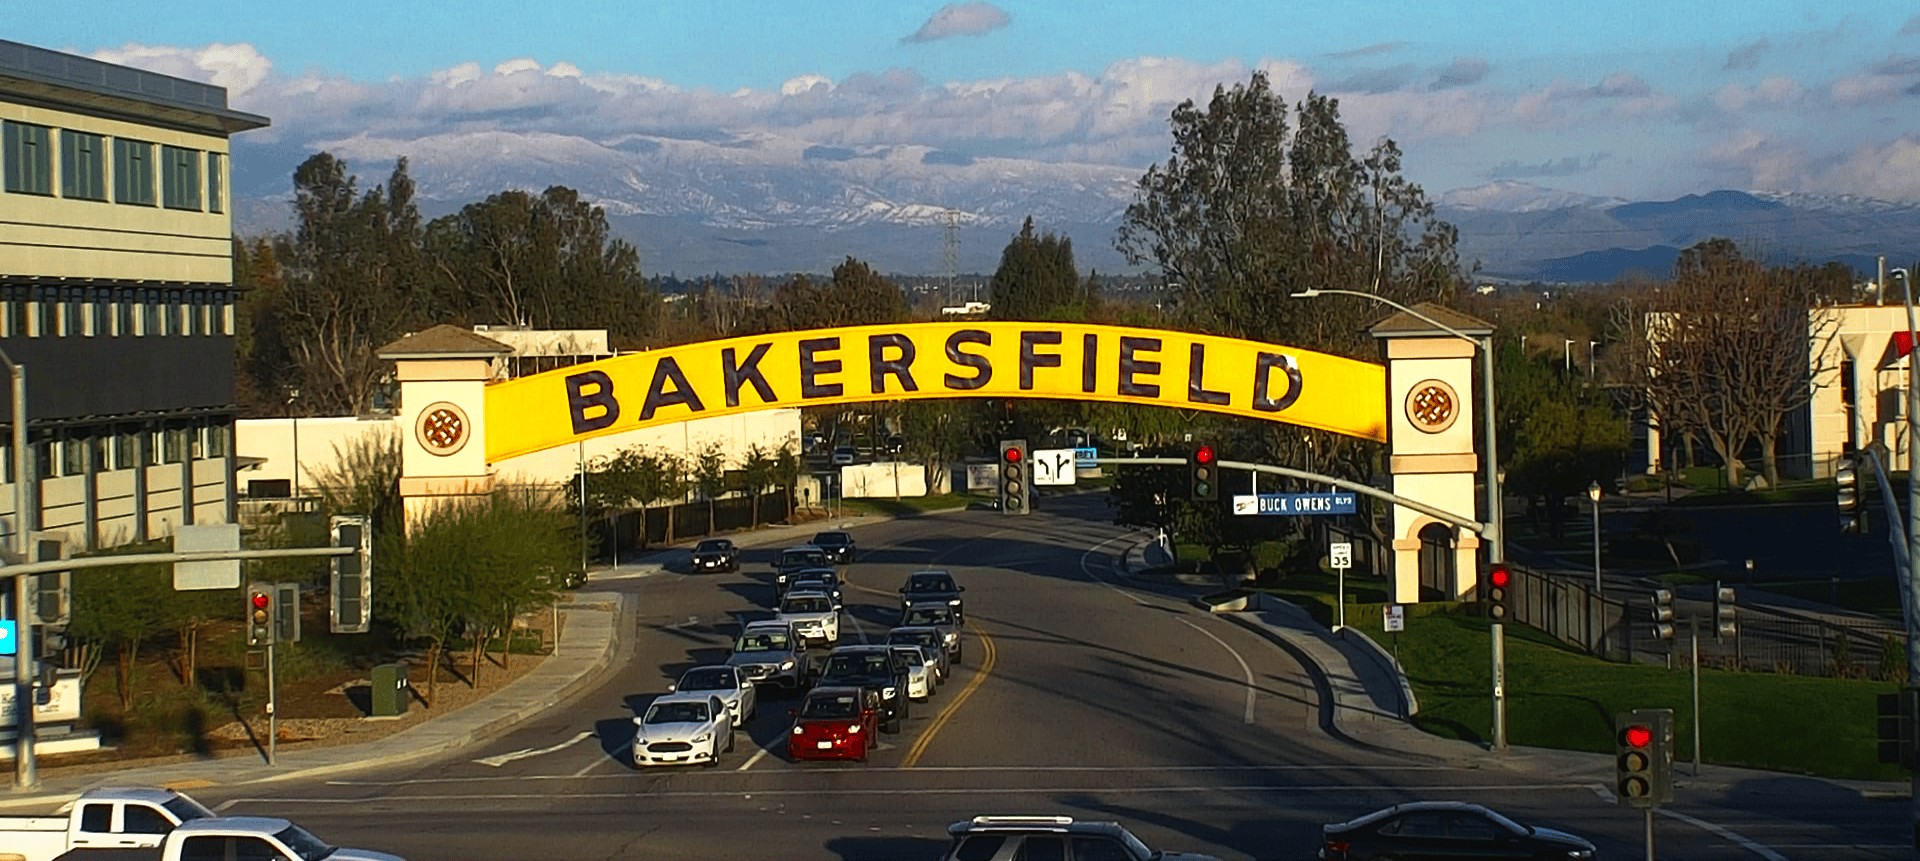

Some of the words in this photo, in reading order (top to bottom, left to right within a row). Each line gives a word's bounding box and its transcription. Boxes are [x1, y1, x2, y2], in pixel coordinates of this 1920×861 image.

[566, 330, 1302, 434] BAKERSFIELD
[1260, 498, 1287, 511] BUCK
[1295, 498, 1331, 511] OWENS
[1333, 556, 1349, 566] 35
